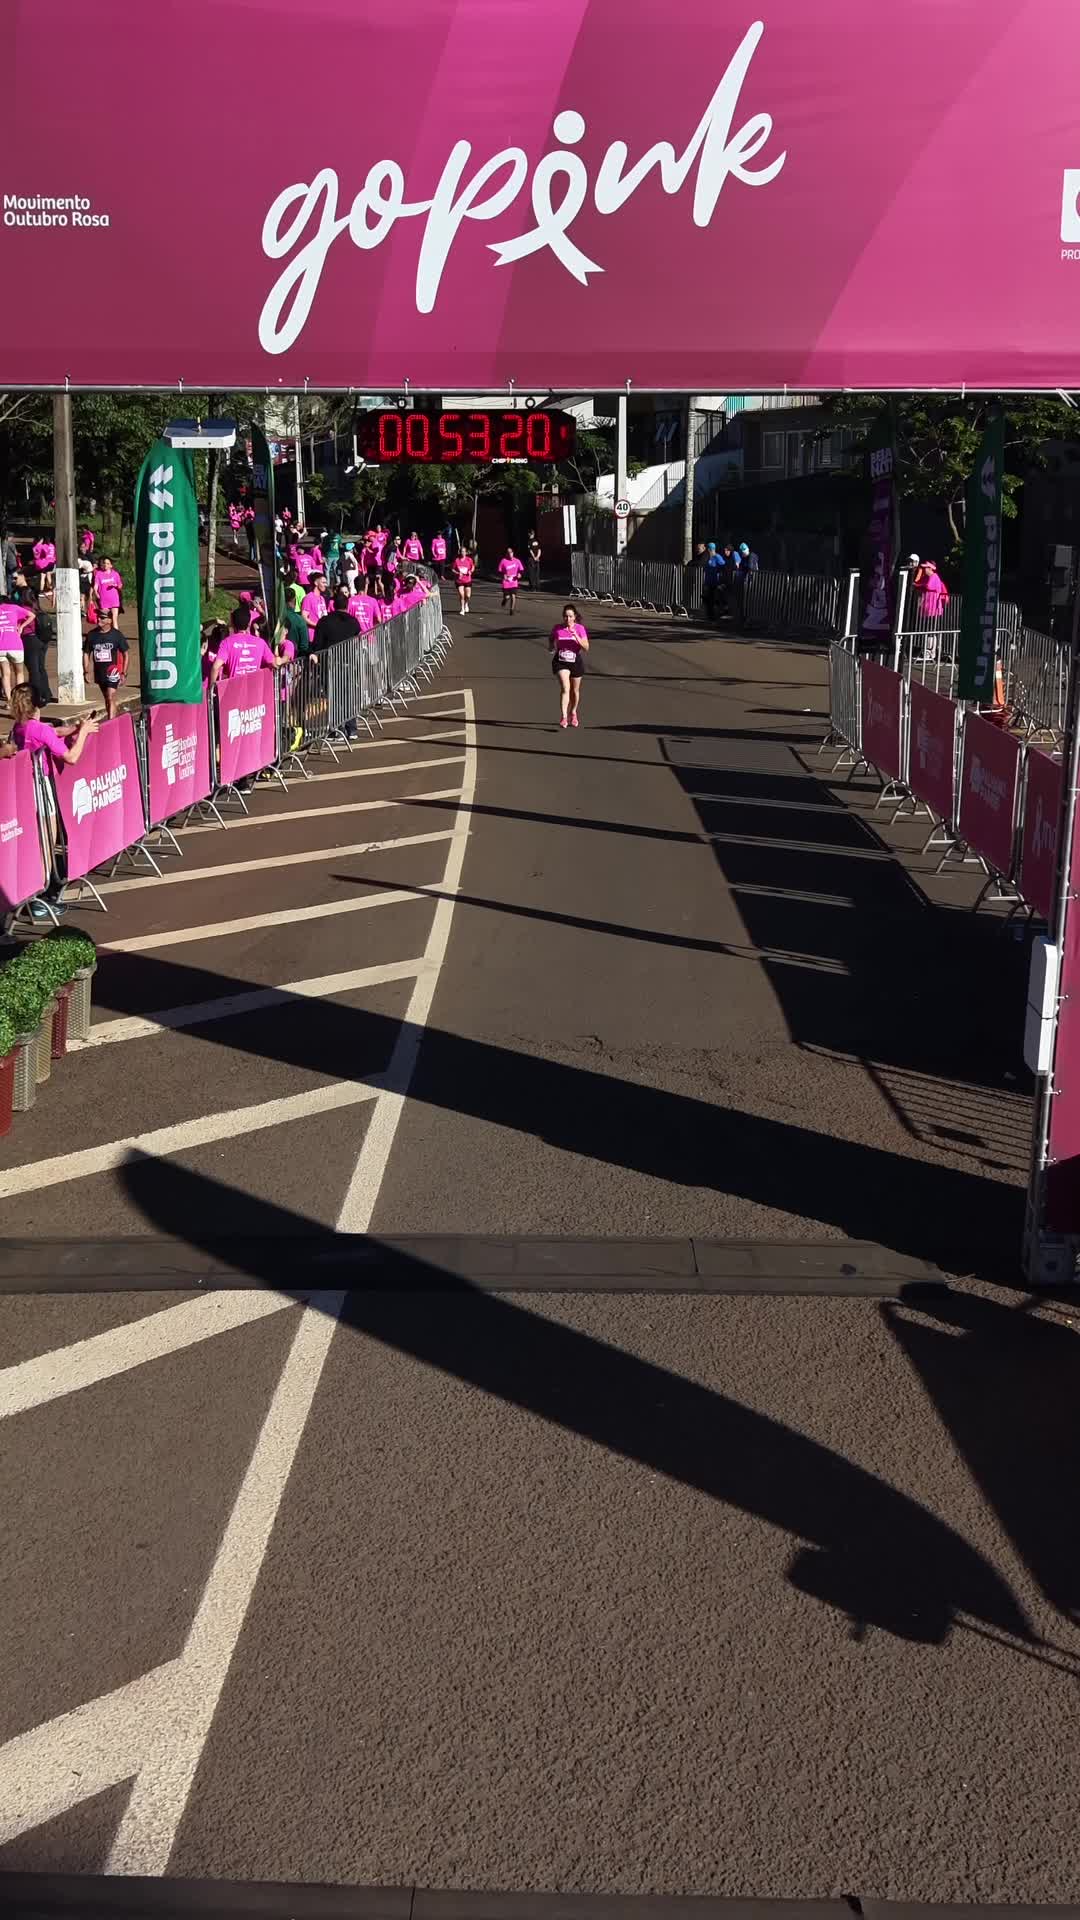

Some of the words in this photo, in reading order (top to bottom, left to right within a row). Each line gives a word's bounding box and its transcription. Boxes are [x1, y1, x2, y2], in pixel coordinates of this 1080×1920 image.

[3, 211, 68, 226] Outubro
[72, 211, 110, 226] Rosa
[616, 503, 628, 511] 40
[147, 522, 178, 690] Unimed
[90, 764, 127, 796] PALHANO
